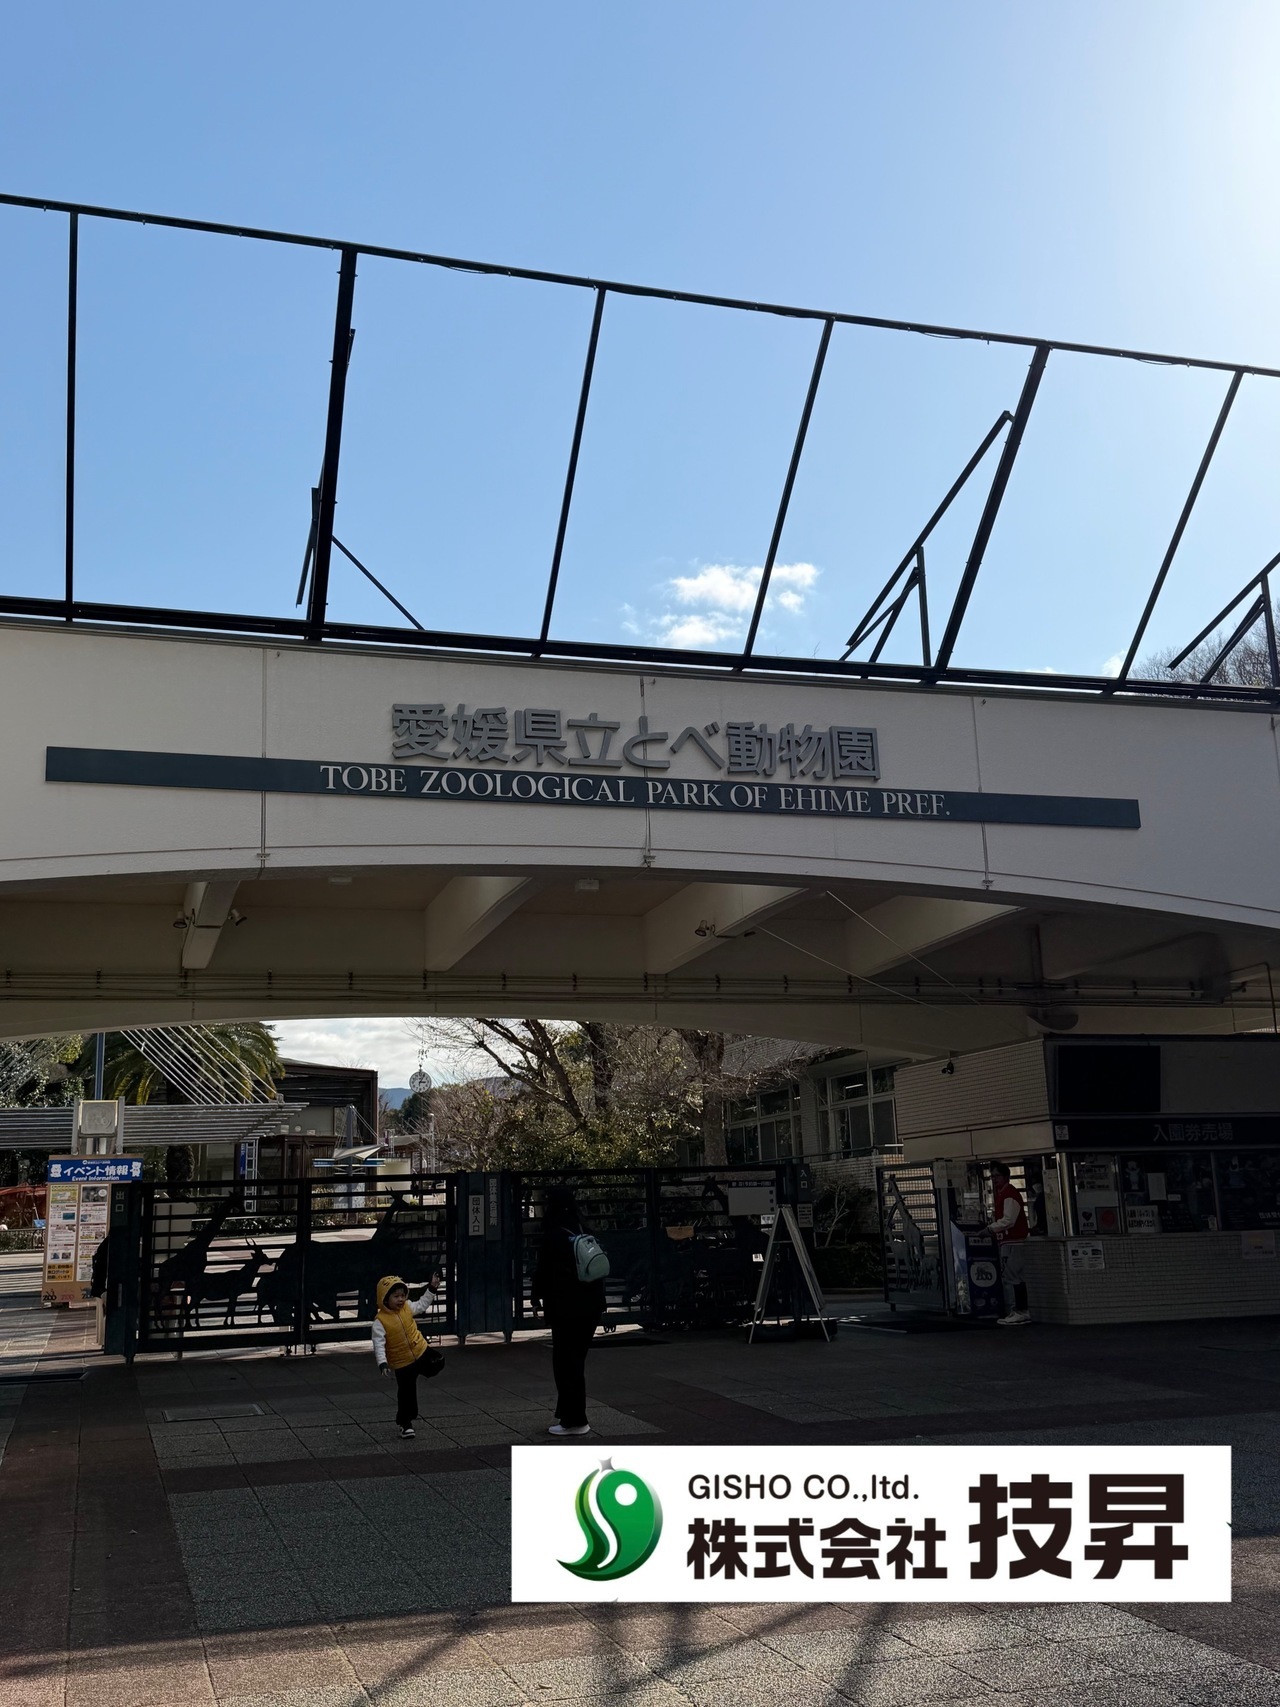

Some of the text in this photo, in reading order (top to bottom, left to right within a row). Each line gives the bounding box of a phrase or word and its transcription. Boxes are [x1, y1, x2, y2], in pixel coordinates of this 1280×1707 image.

[392, 703, 881, 780] 愛媛県立とべ動物園
[320, 765, 951, 816] TOBE ZOOLOGICAL PARK OF EHIME PREF.
[1153, 1122, 1233, 1141] 入園券売場
[63, 1165, 129, 1177] イベント情報
[800, 1170, 808, 1189] 入口
[115, 1190, 125, 1213] 出口
[472, 1197, 481, 1233] 団体入口
